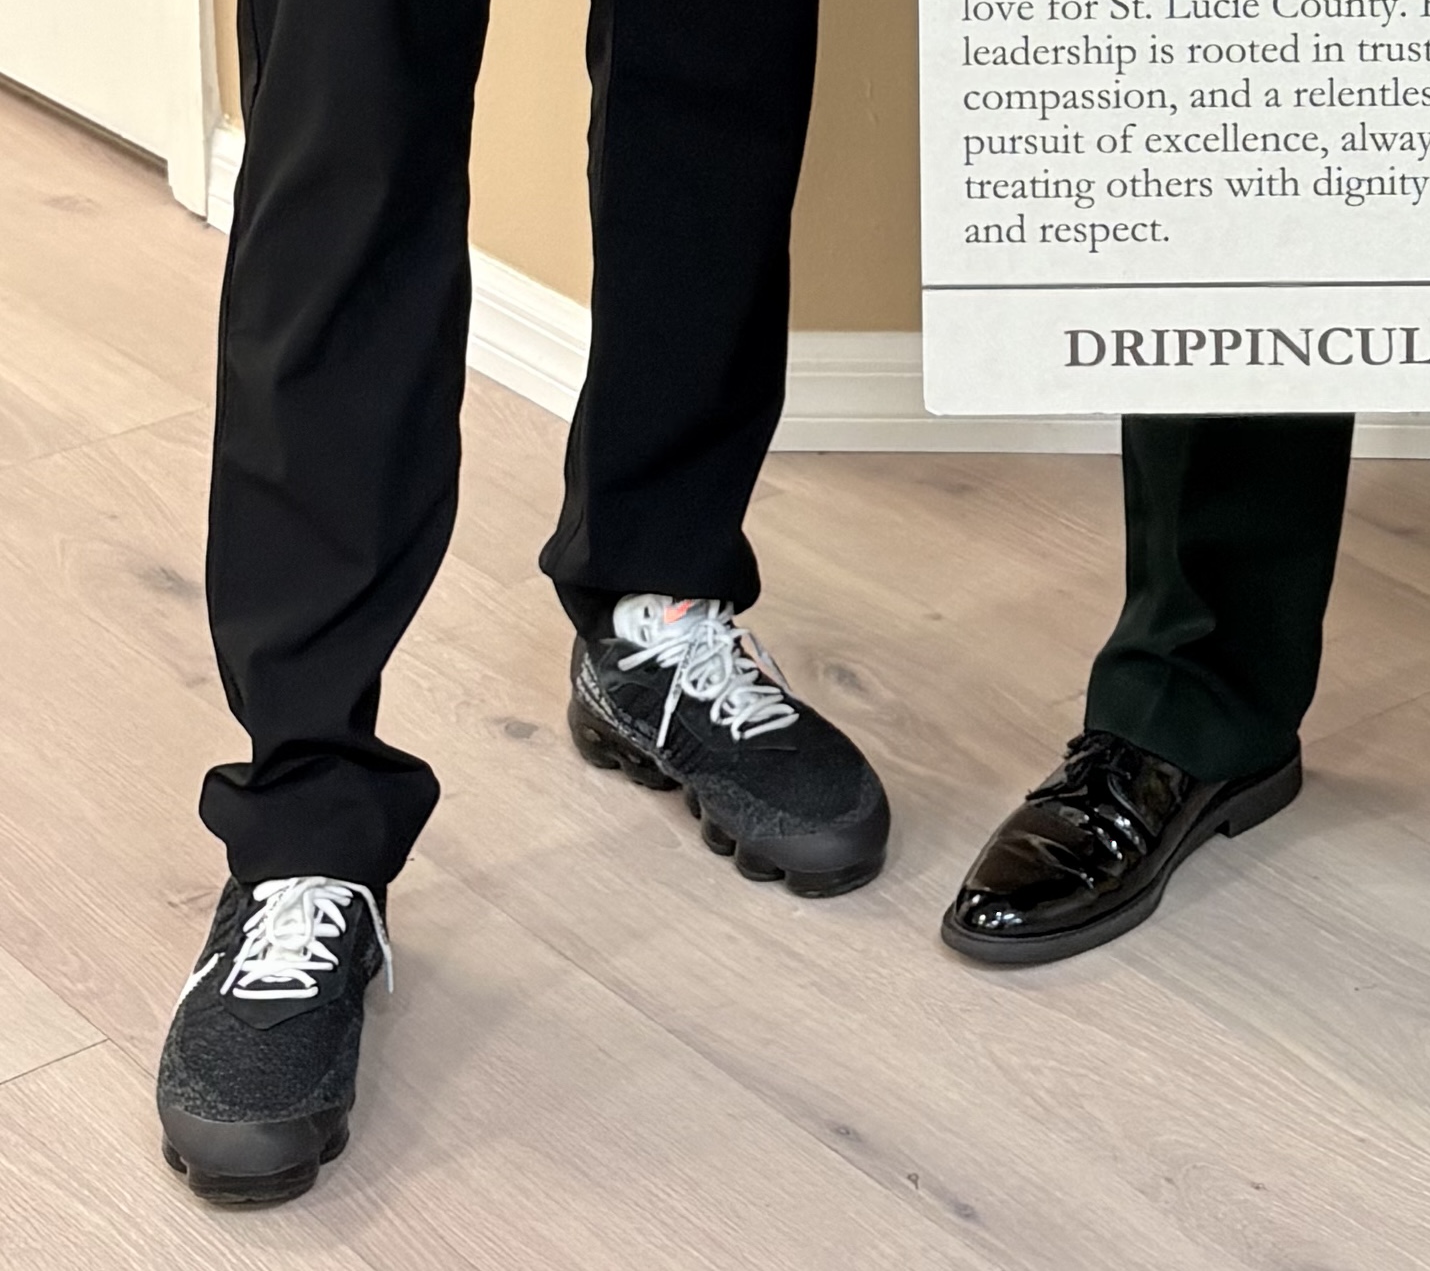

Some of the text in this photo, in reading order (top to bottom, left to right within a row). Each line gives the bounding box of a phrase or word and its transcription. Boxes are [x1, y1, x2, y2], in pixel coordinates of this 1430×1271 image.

[963, 35, 1136, 75] leadership
[1150, 35, 1173, 63] is
[1188, 33, 1299, 63] rooted
[1313, 33, 1344, 62] in
[964, 80, 1177, 120] compassion,
[1190, 78, 1251, 107] and
[1265, 89, 1281, 107] a
[964, 125, 1084, 165] pursuit
[1097, 124, 1136, 153] of
[1146, 123, 1328, 158] excellence,
[966, 166, 1429, 208] treating others with dignity
[965, 214, 1168, 253] and respect.
